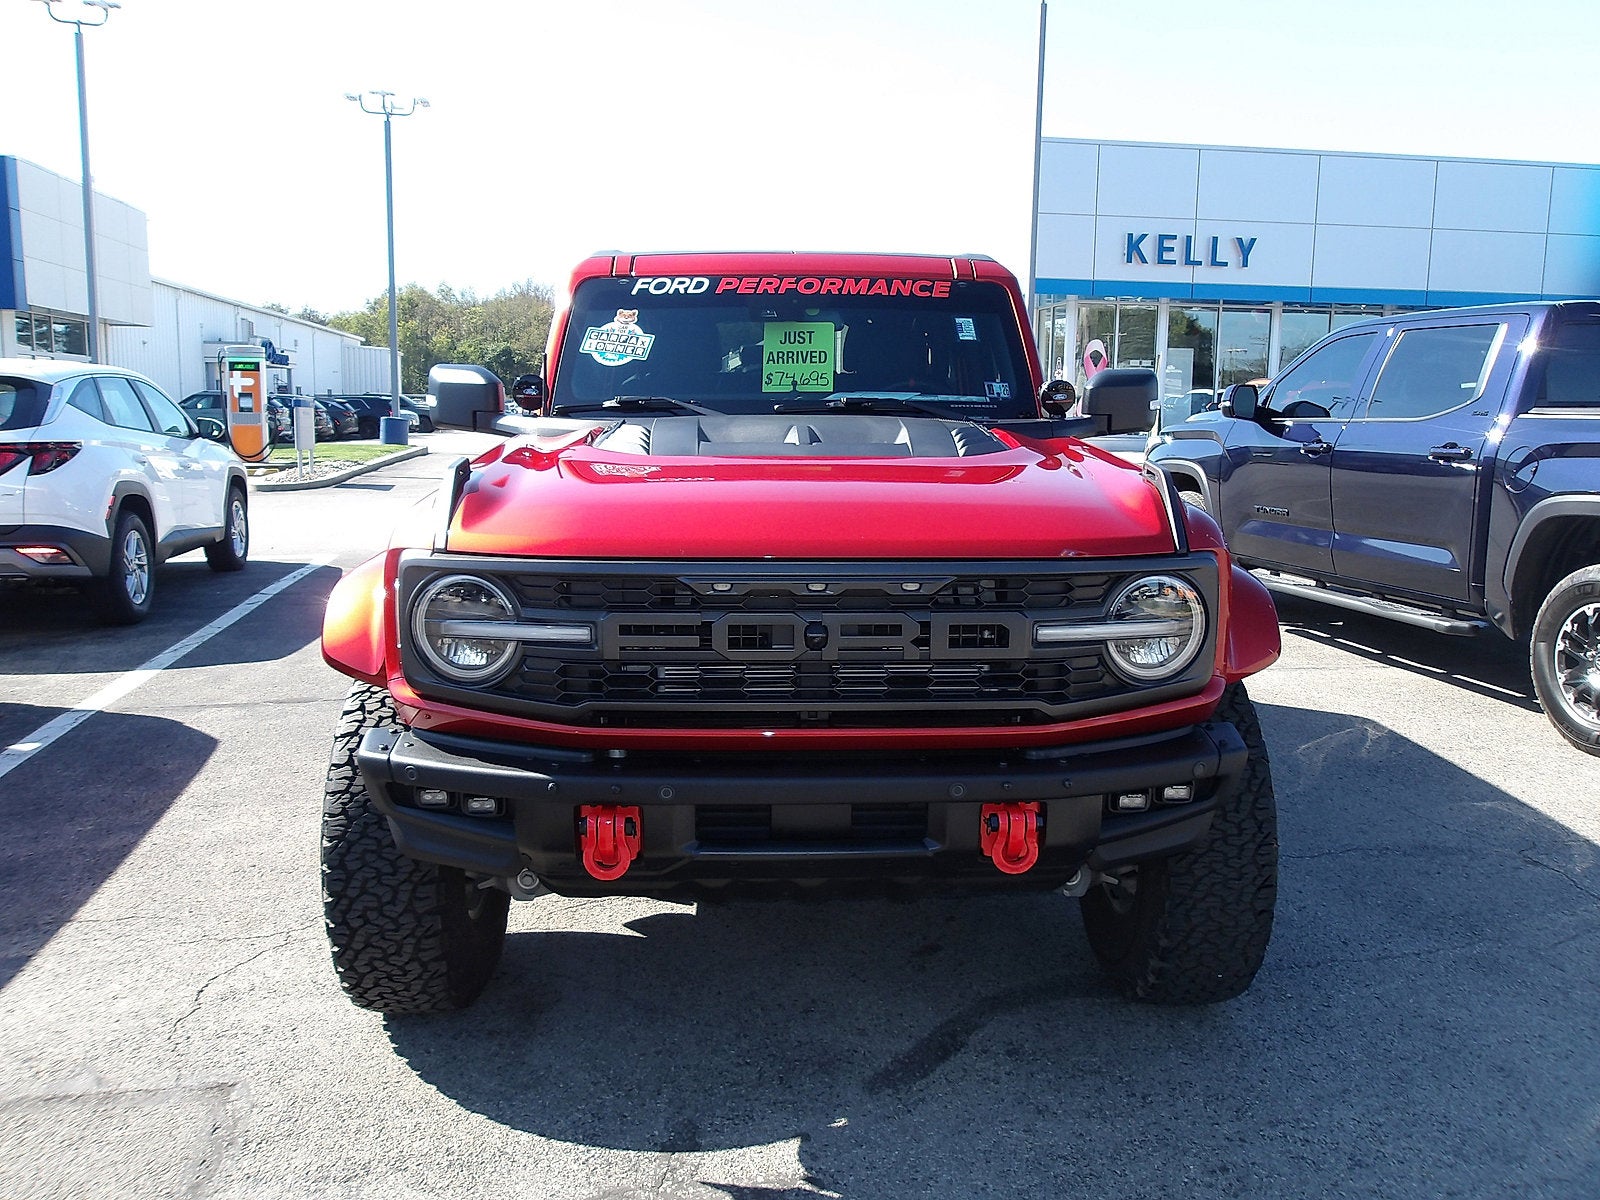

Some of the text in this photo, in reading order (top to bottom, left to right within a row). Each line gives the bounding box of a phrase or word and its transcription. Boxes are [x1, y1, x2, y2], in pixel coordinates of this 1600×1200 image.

[1125, 233, 1257, 268] KELLY
[631, 277, 952, 298] FORD PERFORMANCE
[589, 331, 647, 347] CARFAX
[780, 330, 815, 345] JUST
[595, 341, 646, 356] OWNER
[765, 350, 828, 365] ARRIVED
[602, 611, 1030, 660] FORD
